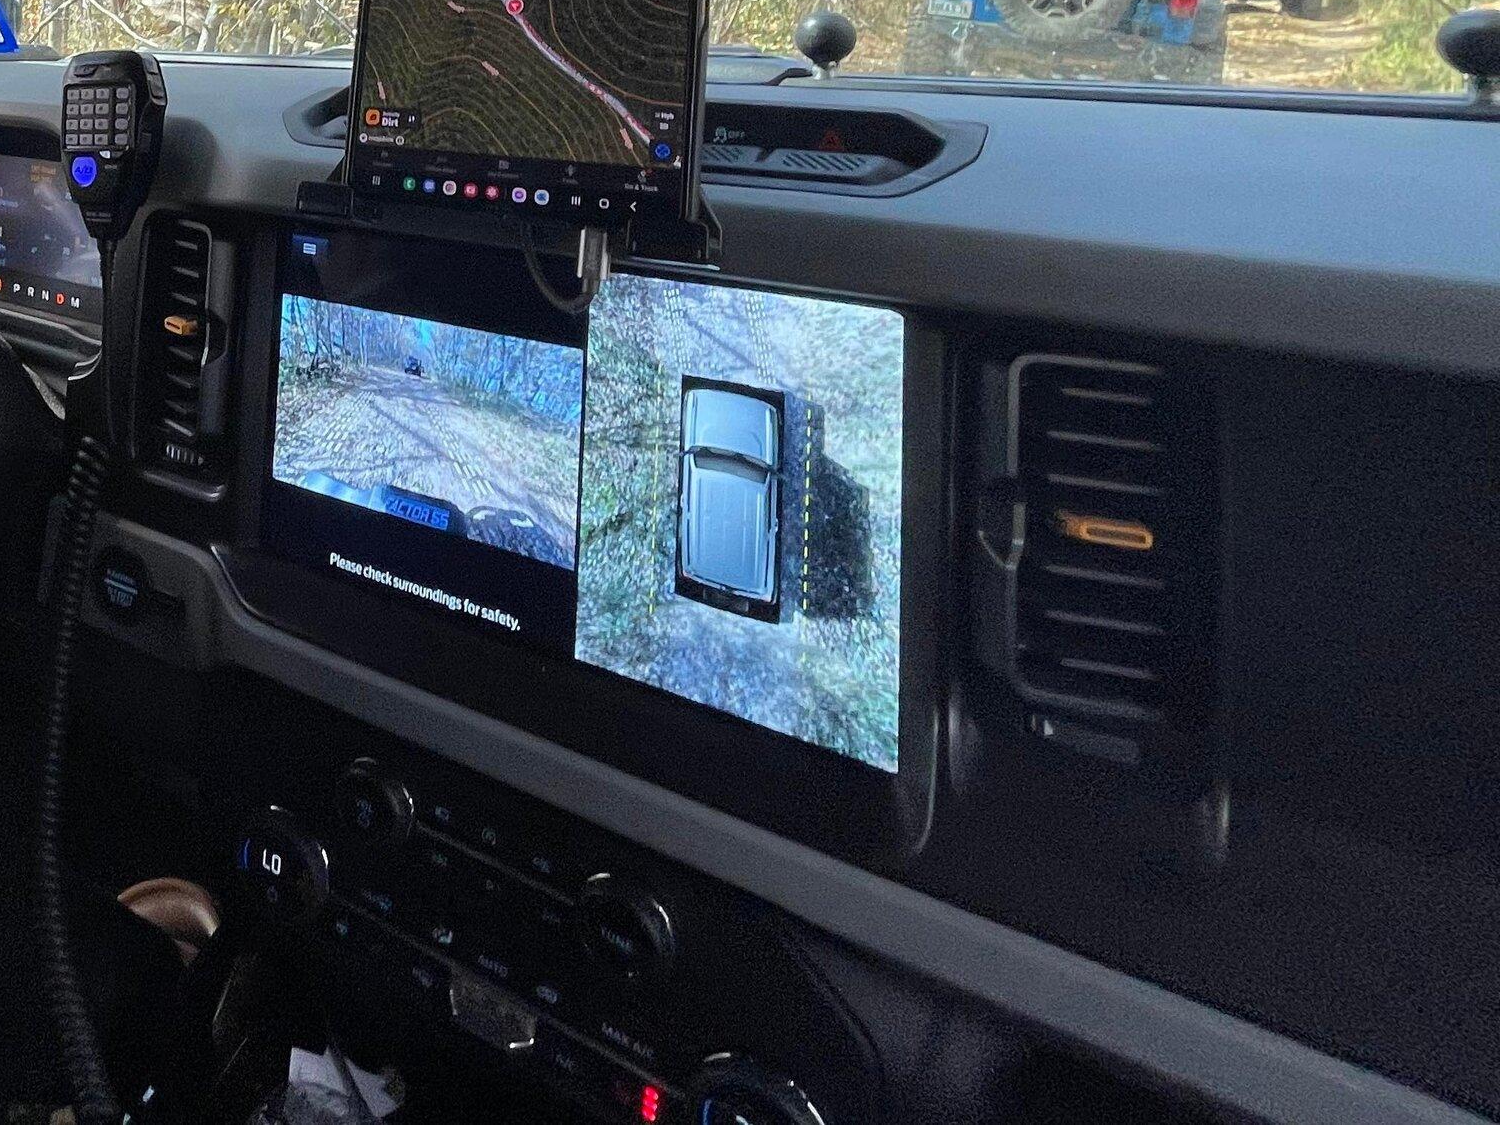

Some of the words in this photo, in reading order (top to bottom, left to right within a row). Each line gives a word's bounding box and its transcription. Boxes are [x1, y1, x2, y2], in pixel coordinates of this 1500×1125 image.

[380, 116, 399, 127] Dirt
[12, 282, 21, 293] P
[26, 285, 35, 297] R
[41, 288, 50, 301] N
[55, 292, 66, 306] D
[70, 296, 80, 309] M
[330, 552, 362, 577] Please
[362, 564, 393, 588] check
[393, 573, 462, 611] surroundings
[462, 597, 481, 617] for
[480, 603, 522, 632] safety.
[262, 848, 282, 876] LO
